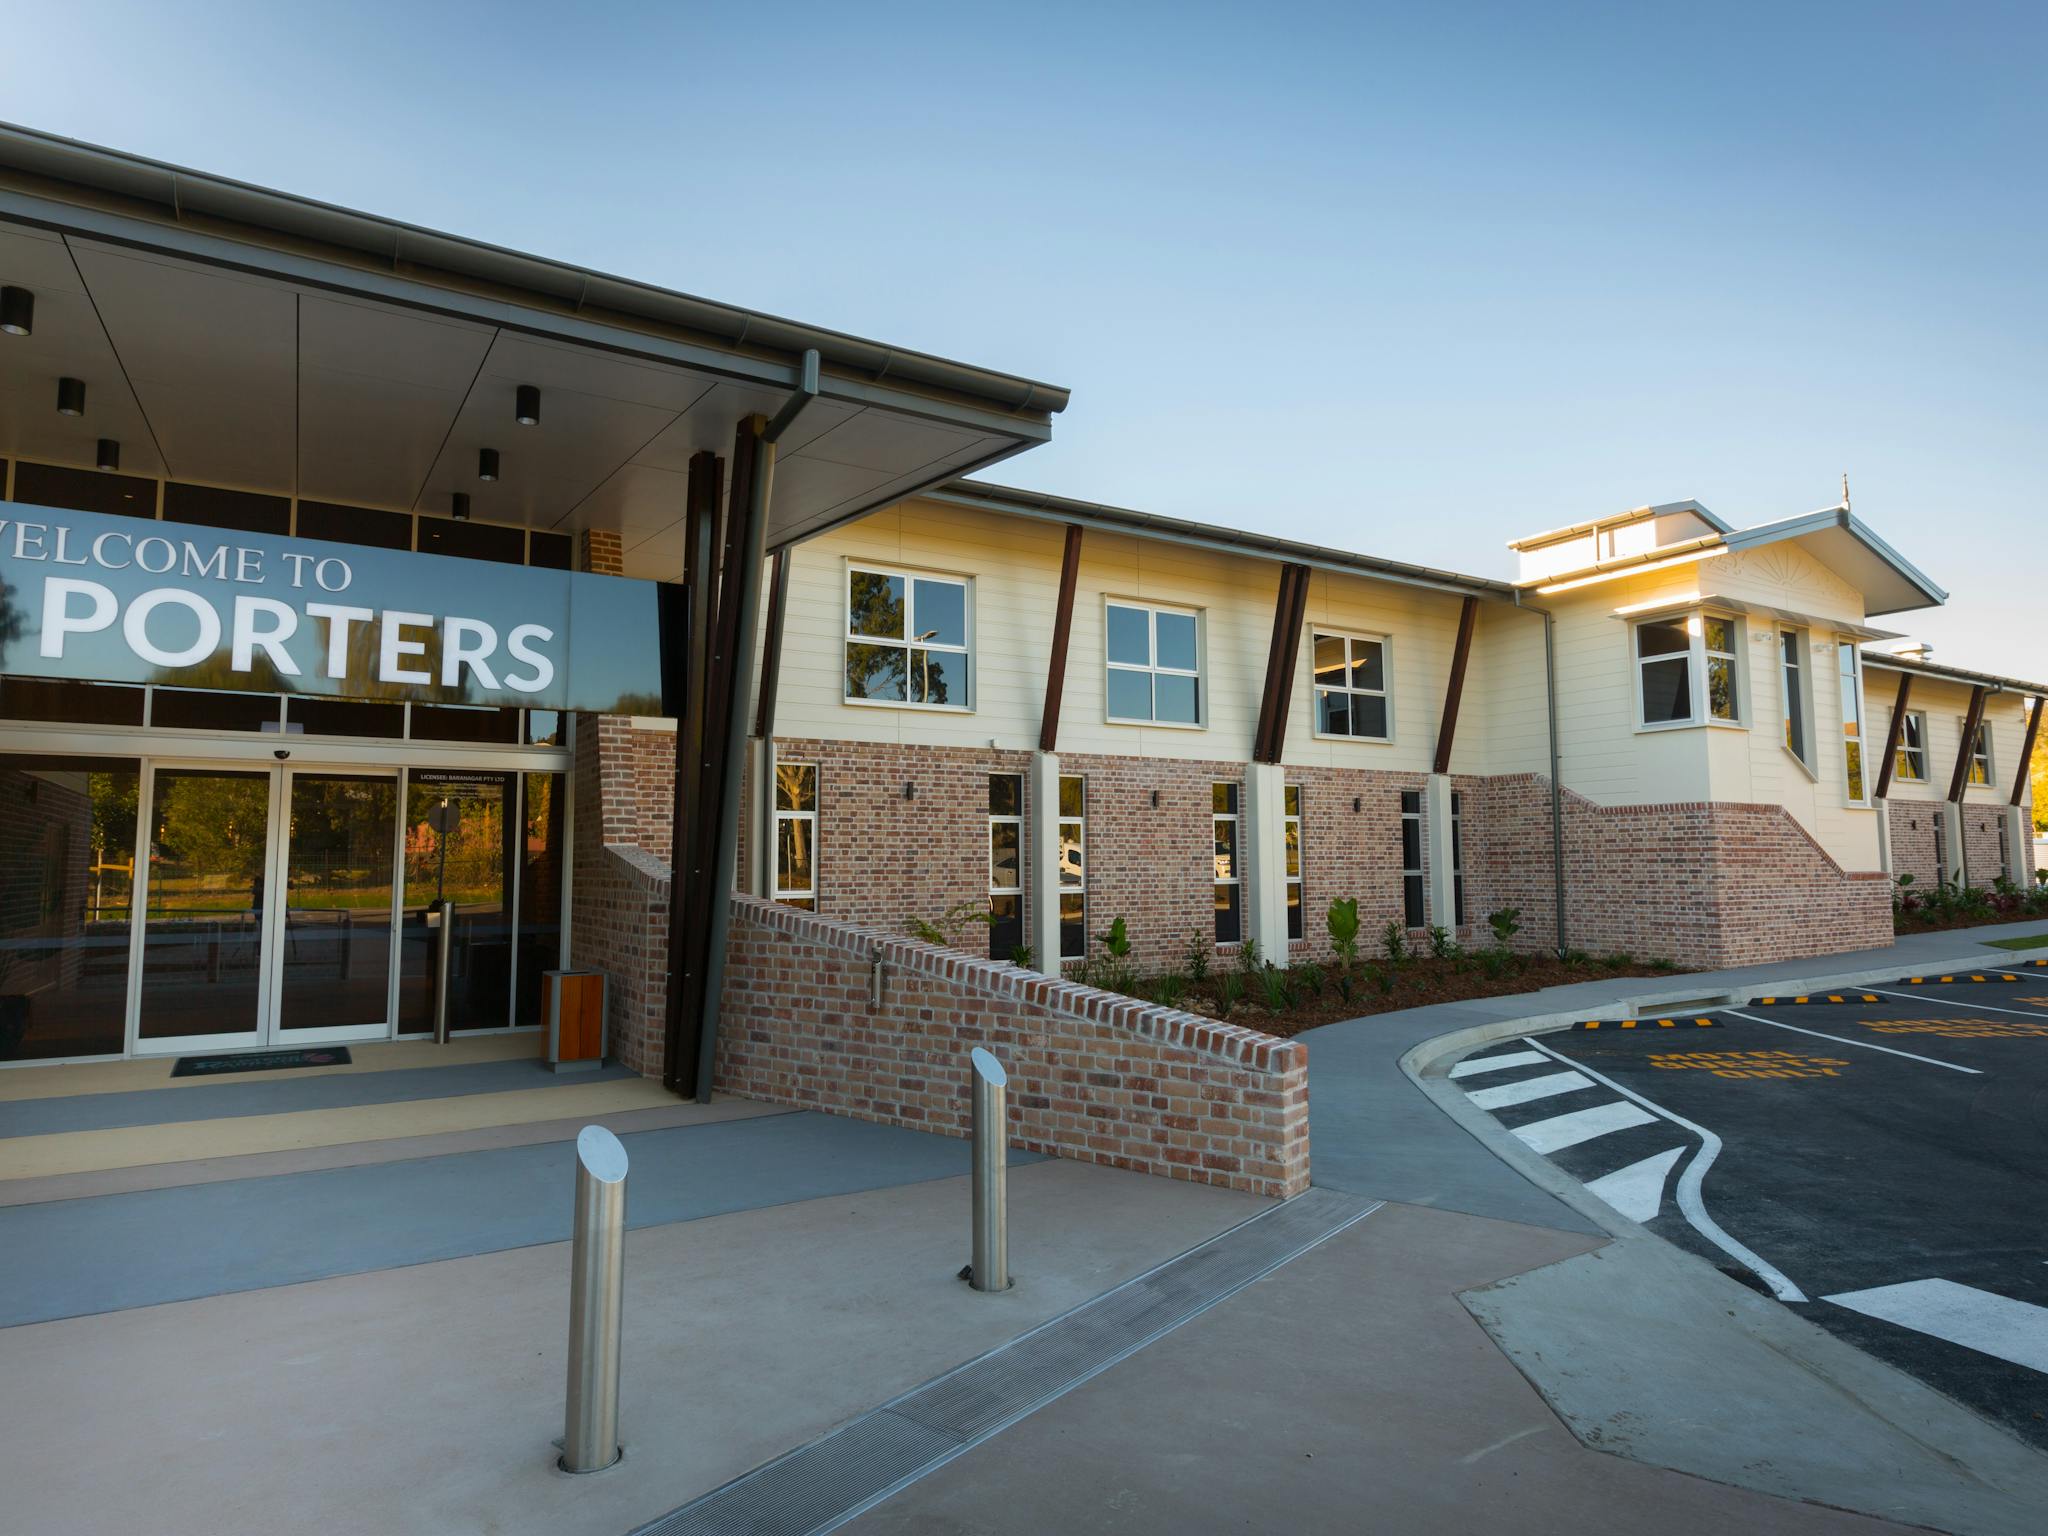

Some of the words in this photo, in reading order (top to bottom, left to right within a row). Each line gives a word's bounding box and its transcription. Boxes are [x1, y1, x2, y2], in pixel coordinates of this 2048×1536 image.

[0, 519, 265, 584] ELCOME
[282, 553, 352, 592] TO
[40, 576, 554, 693] PORTERS
[1647, 1050, 1809, 1061] MOTEL
[1649, 1057, 1851, 1070] GUESTS
[1711, 1067, 1842, 1079] ONLY
